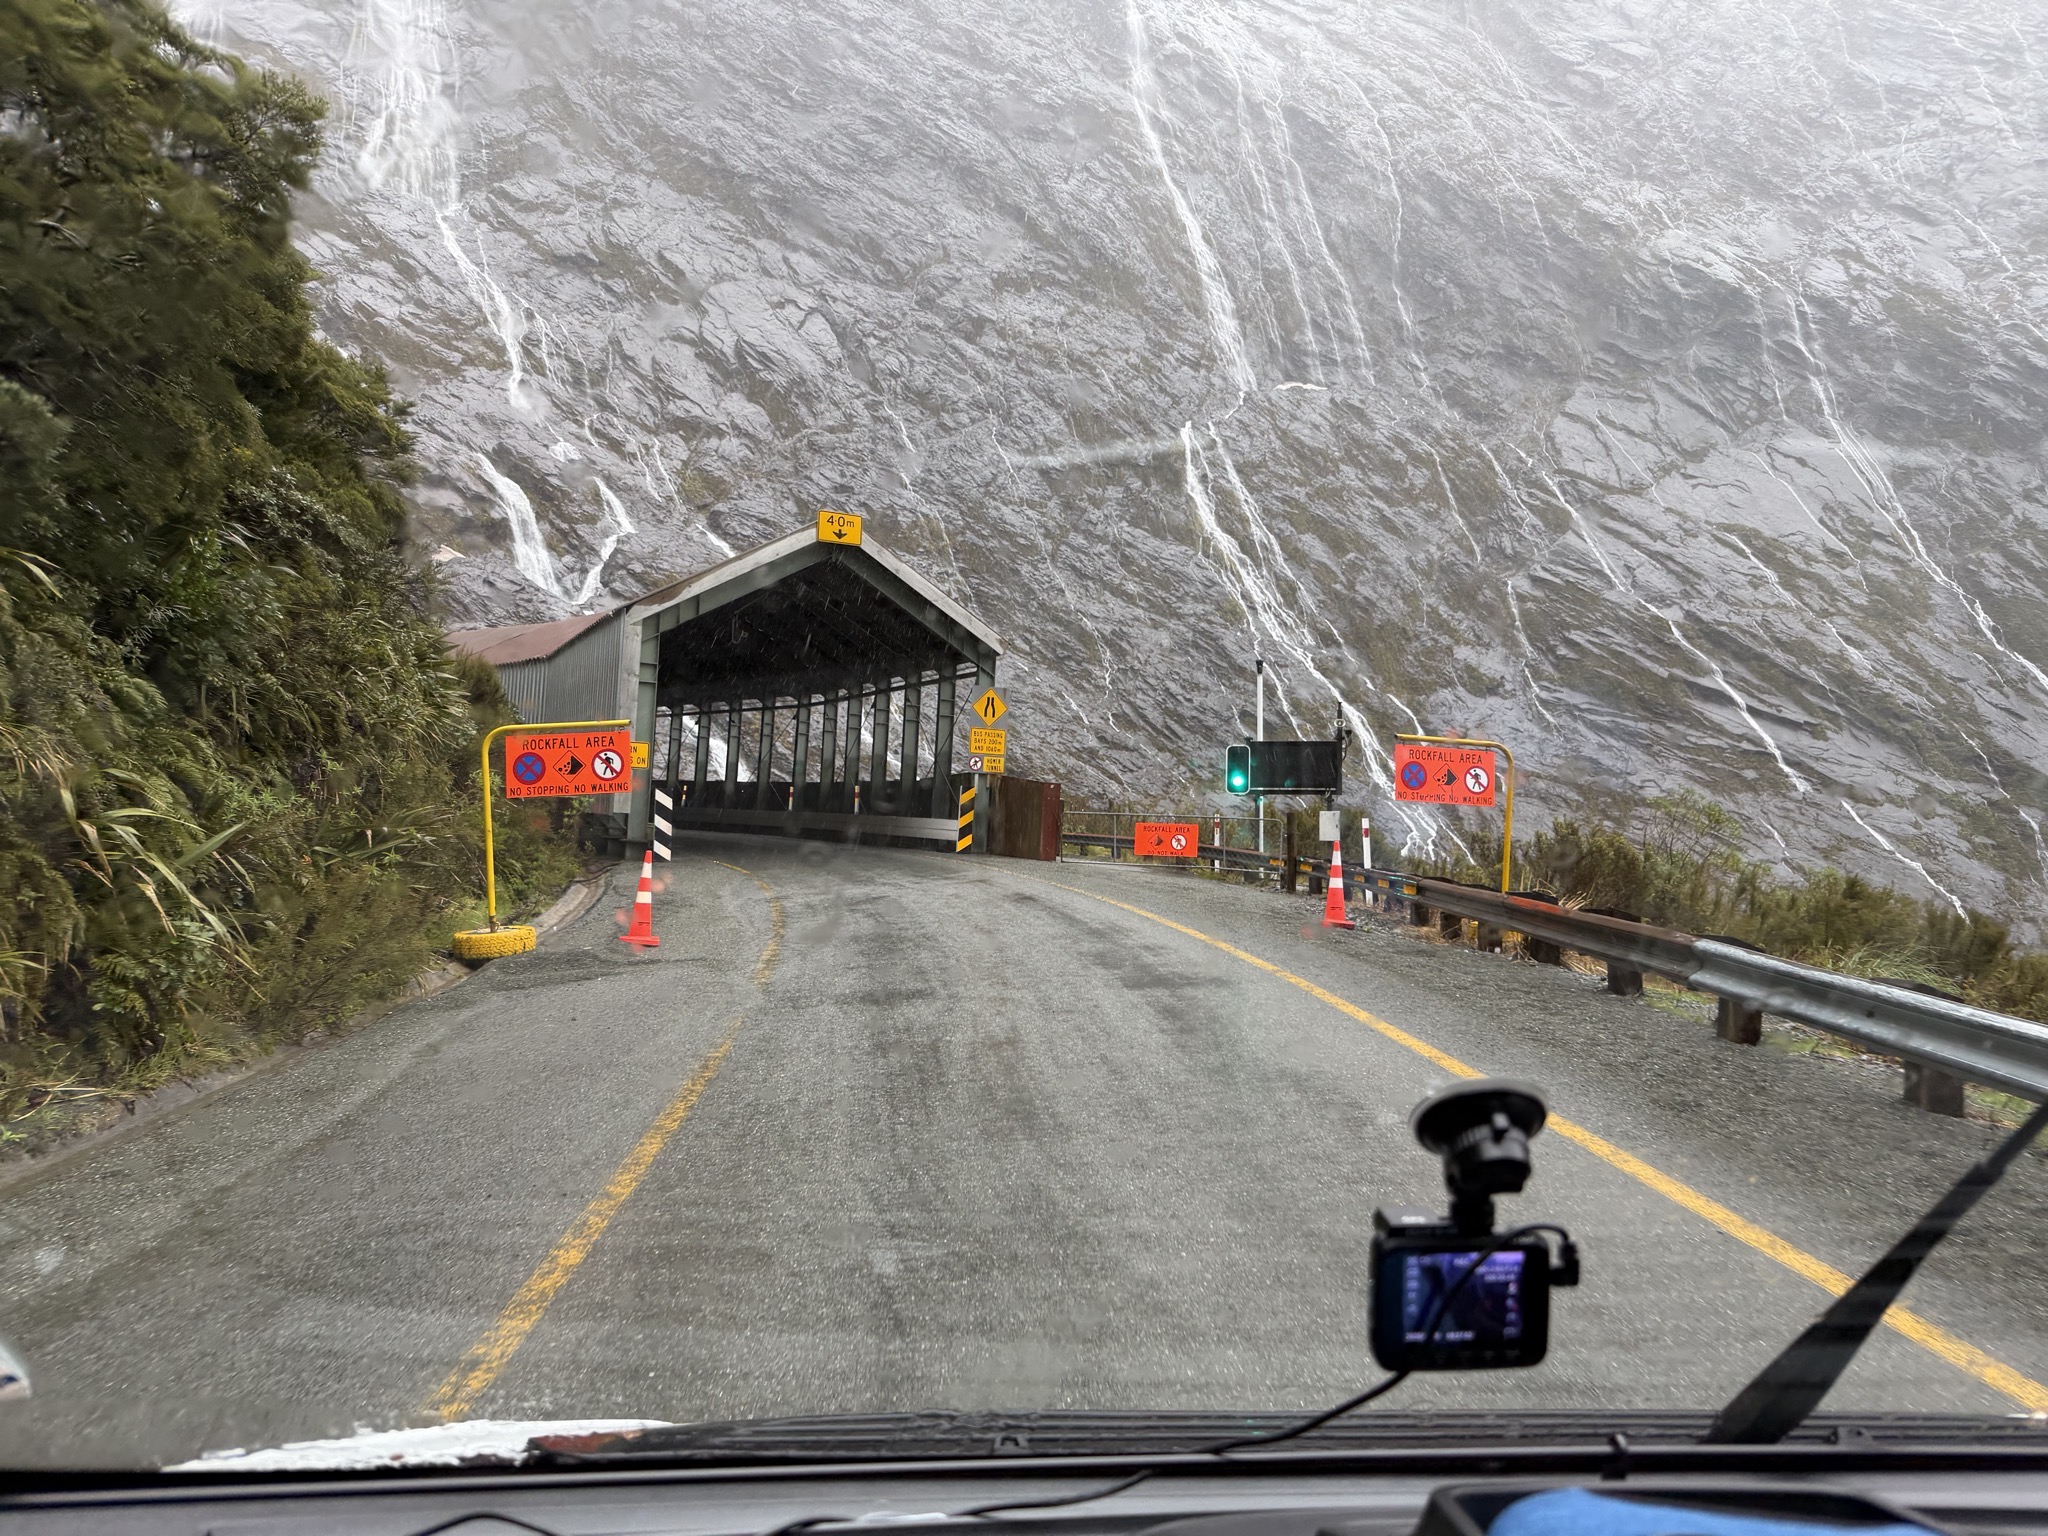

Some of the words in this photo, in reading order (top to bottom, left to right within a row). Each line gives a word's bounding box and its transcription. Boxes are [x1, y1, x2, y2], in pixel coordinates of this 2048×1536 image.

[522, 737, 579, 750] ROCKFALL
[585, 736, 615, 747] AREA
[1409, 749, 1454, 762] ROCKFALL
[1459, 753, 1483, 764] AREA
[510, 787, 522, 796] NO
[526, 785, 570, 795] STOPPING
[574, 784, 586, 793] NO
[591, 782, 629, 792] WALKING
[1397, 791, 1407, 800] NO
[1462, 796, 1493, 806] WALKING
